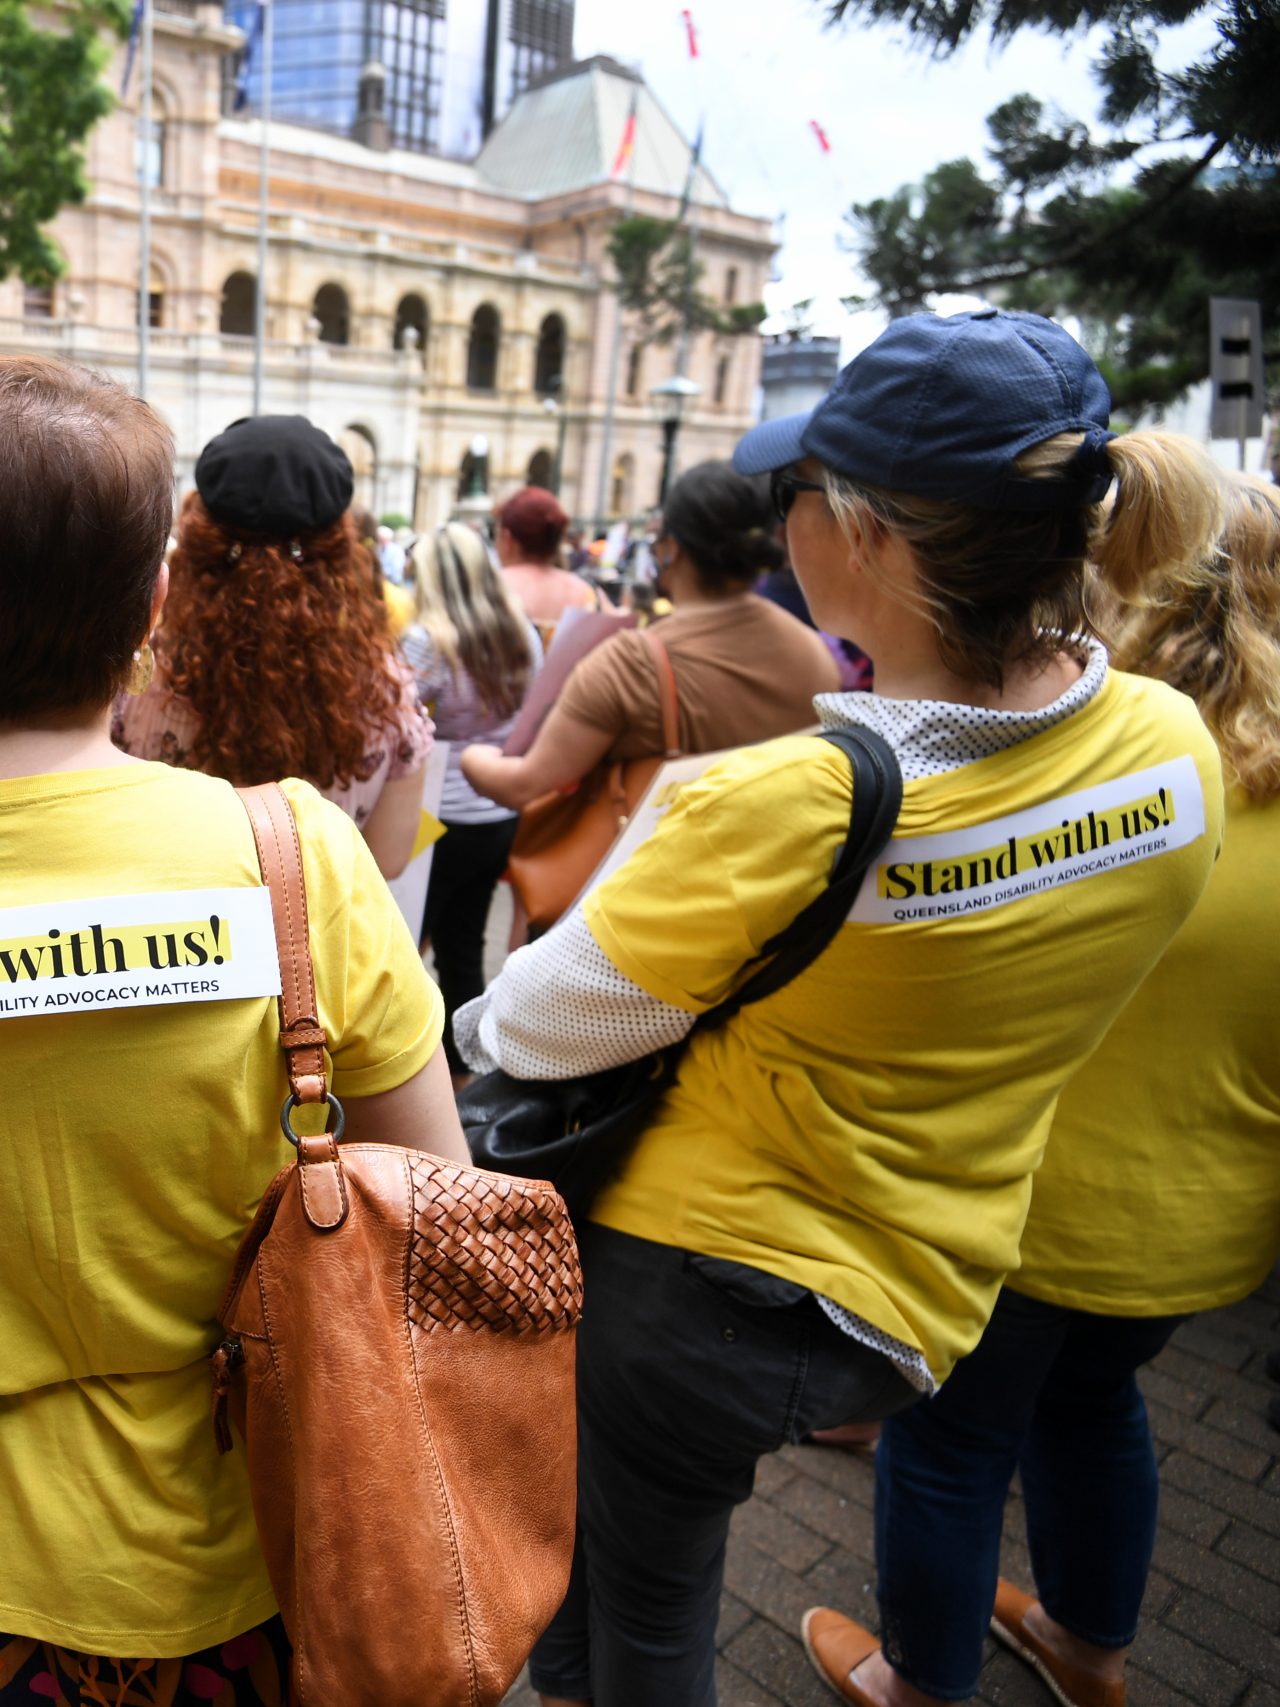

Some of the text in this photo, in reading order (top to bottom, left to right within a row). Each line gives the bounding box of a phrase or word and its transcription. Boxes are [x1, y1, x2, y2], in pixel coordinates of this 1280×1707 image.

[886, 787, 1170, 900] Stand with us!
[894, 837, 1167, 921] QUEENSLAND DISABILITY ADVOCACY MATTERS
[143, 914, 225, 970] us!
[44, 985, 141, 1007] ADVOCACY
[145, 979, 220, 997] MATTERS
